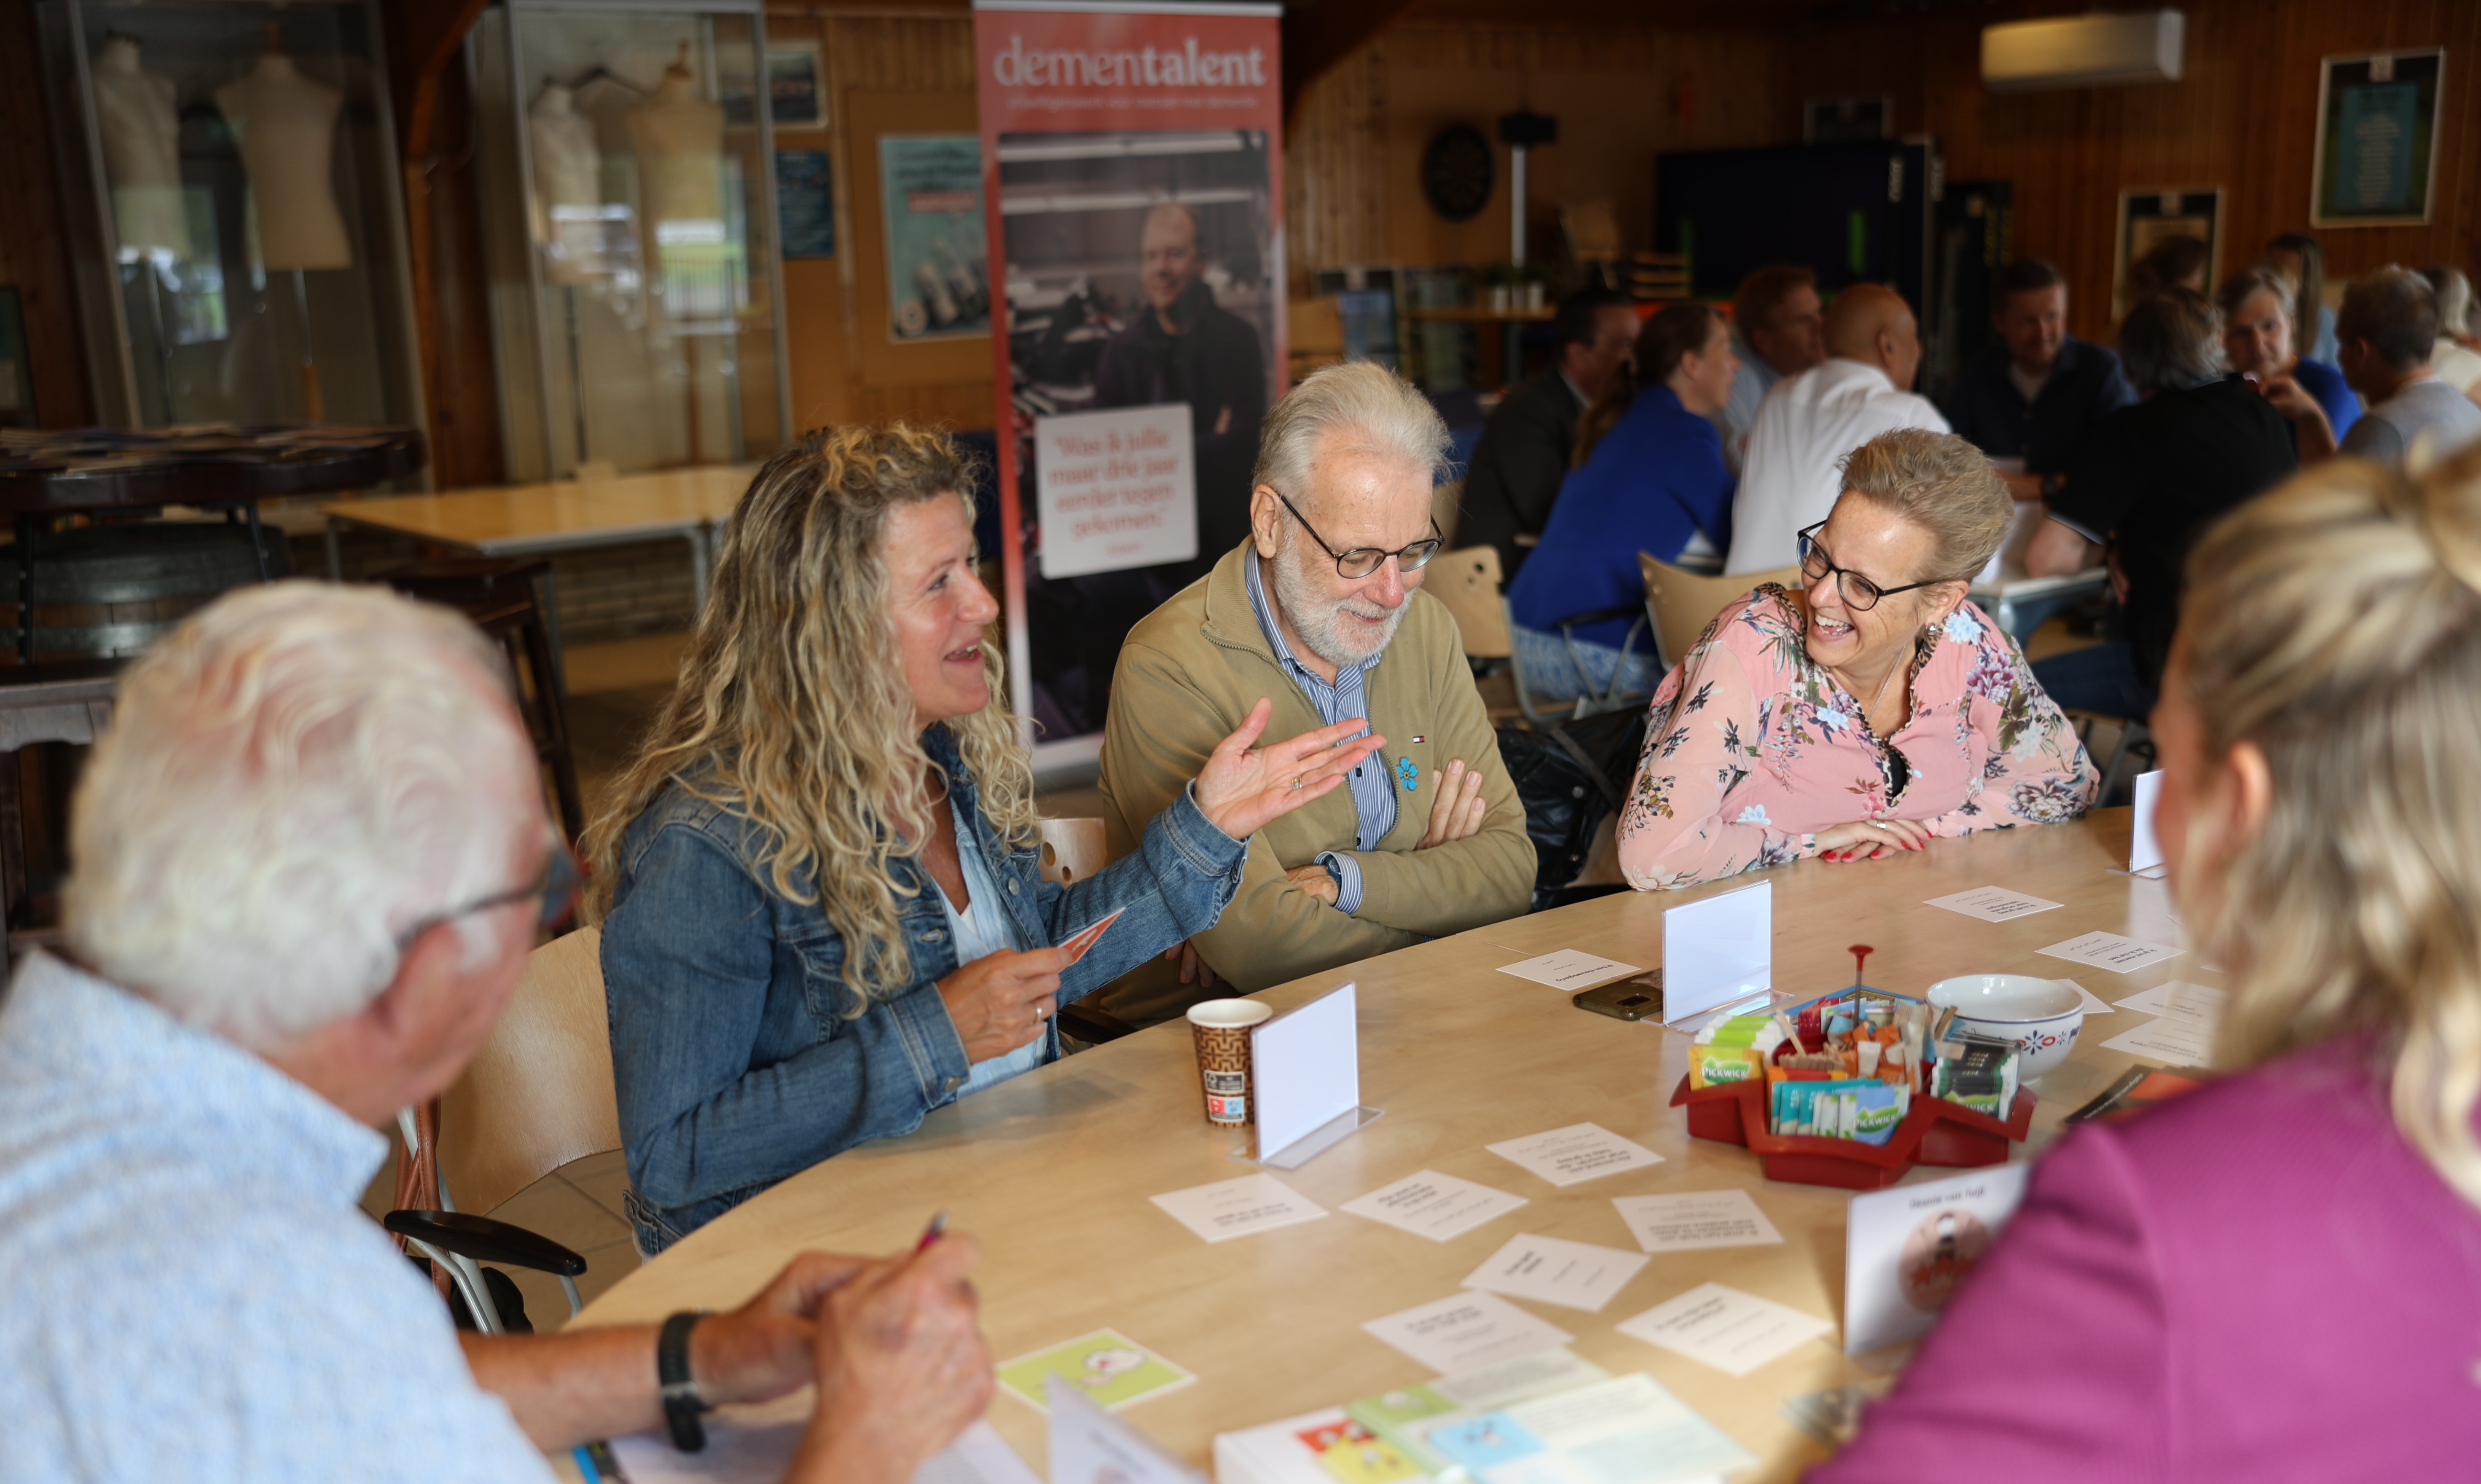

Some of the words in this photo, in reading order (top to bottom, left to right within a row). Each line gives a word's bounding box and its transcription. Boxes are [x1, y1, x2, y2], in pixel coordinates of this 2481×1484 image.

[993, 35, 1267, 86] dementalent
[2113, 955, 2136, 964] mensen
[1555, 969, 1595, 982] nieuwsgierig
[2129, 1041, 2178, 1055] computers
[1701, 1066, 1748, 1079] PICKWICK
[1852, 1114, 1897, 1129] PICKWICK
